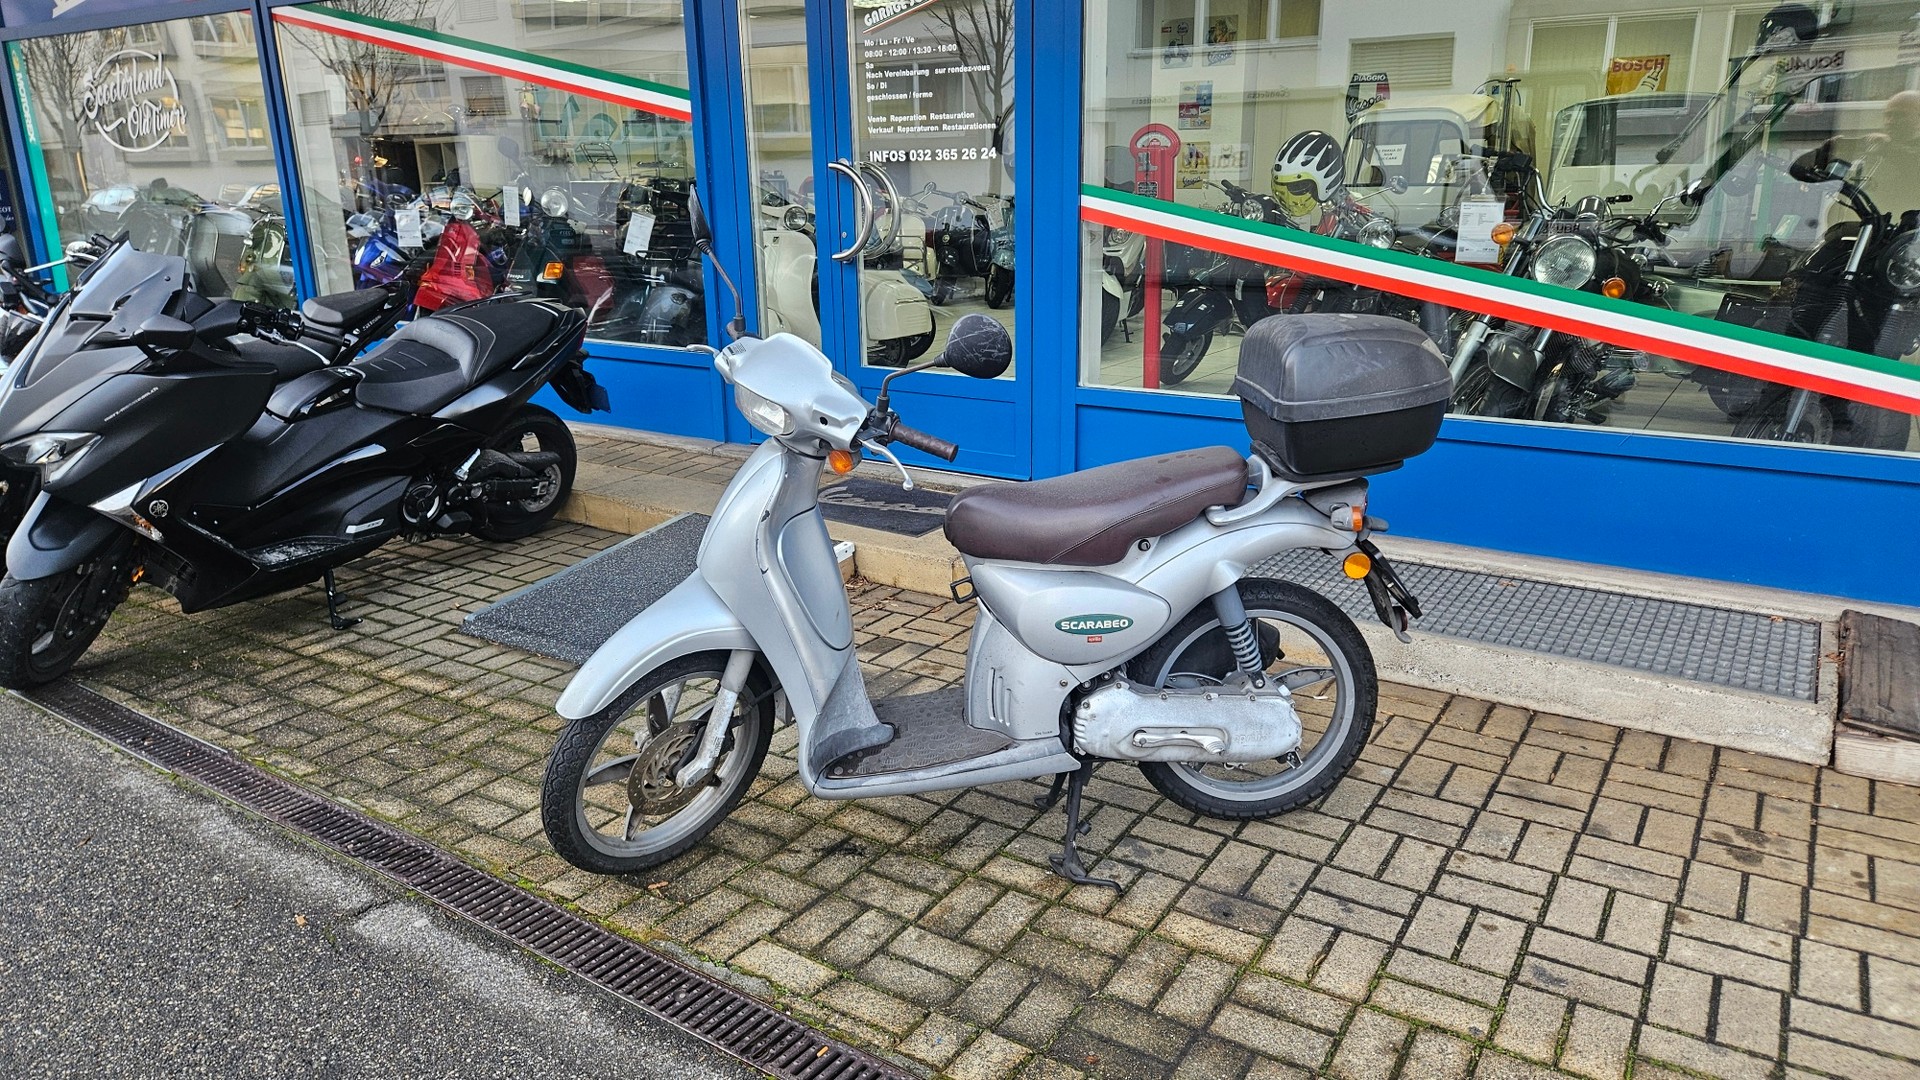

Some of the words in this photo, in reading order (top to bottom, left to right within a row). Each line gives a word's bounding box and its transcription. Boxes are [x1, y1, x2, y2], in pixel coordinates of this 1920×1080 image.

[864, 39, 875, 47] Mo
[879, 37, 888, 46] Lu
[893, 36, 902, 45] Fr
[905, 36, 915, 44] Ve
[864, 50, 883, 58] 08:00
[888, 48, 907, 57] 12:00
[913, 46, 931, 55] 13:30
[865, 62, 874, 70] Sa
[865, 71, 883, 79] Nach
[884, 69, 930, 78] Vereinbarung
[935, 67, 946, 75] sur
[947, 64, 991, 74] rendez-vous
[1612, 58, 1665, 73] BOSCH
[1353, 73, 1387, 82] PIAGGIO
[84, 51, 165, 119] Scooterland
[866, 92, 908, 103] geschlossen
[16, 73, 36, 143] MOTOREX
[867, 115, 886, 124] Vente
[930, 111, 975, 121] Restauration
[868, 126, 894, 134] Verkauf
[897, 124, 939, 134] Reparaturen
[942, 122, 997, 132] Restaurationen
[869, 150, 906, 162] INFOS
[909, 150, 932, 161] 032
[935, 149, 958, 160] 365
[961, 148, 977, 160] 26
[980, 147, 997, 160] 24
[1060, 618, 1129, 630] SCARABEO
